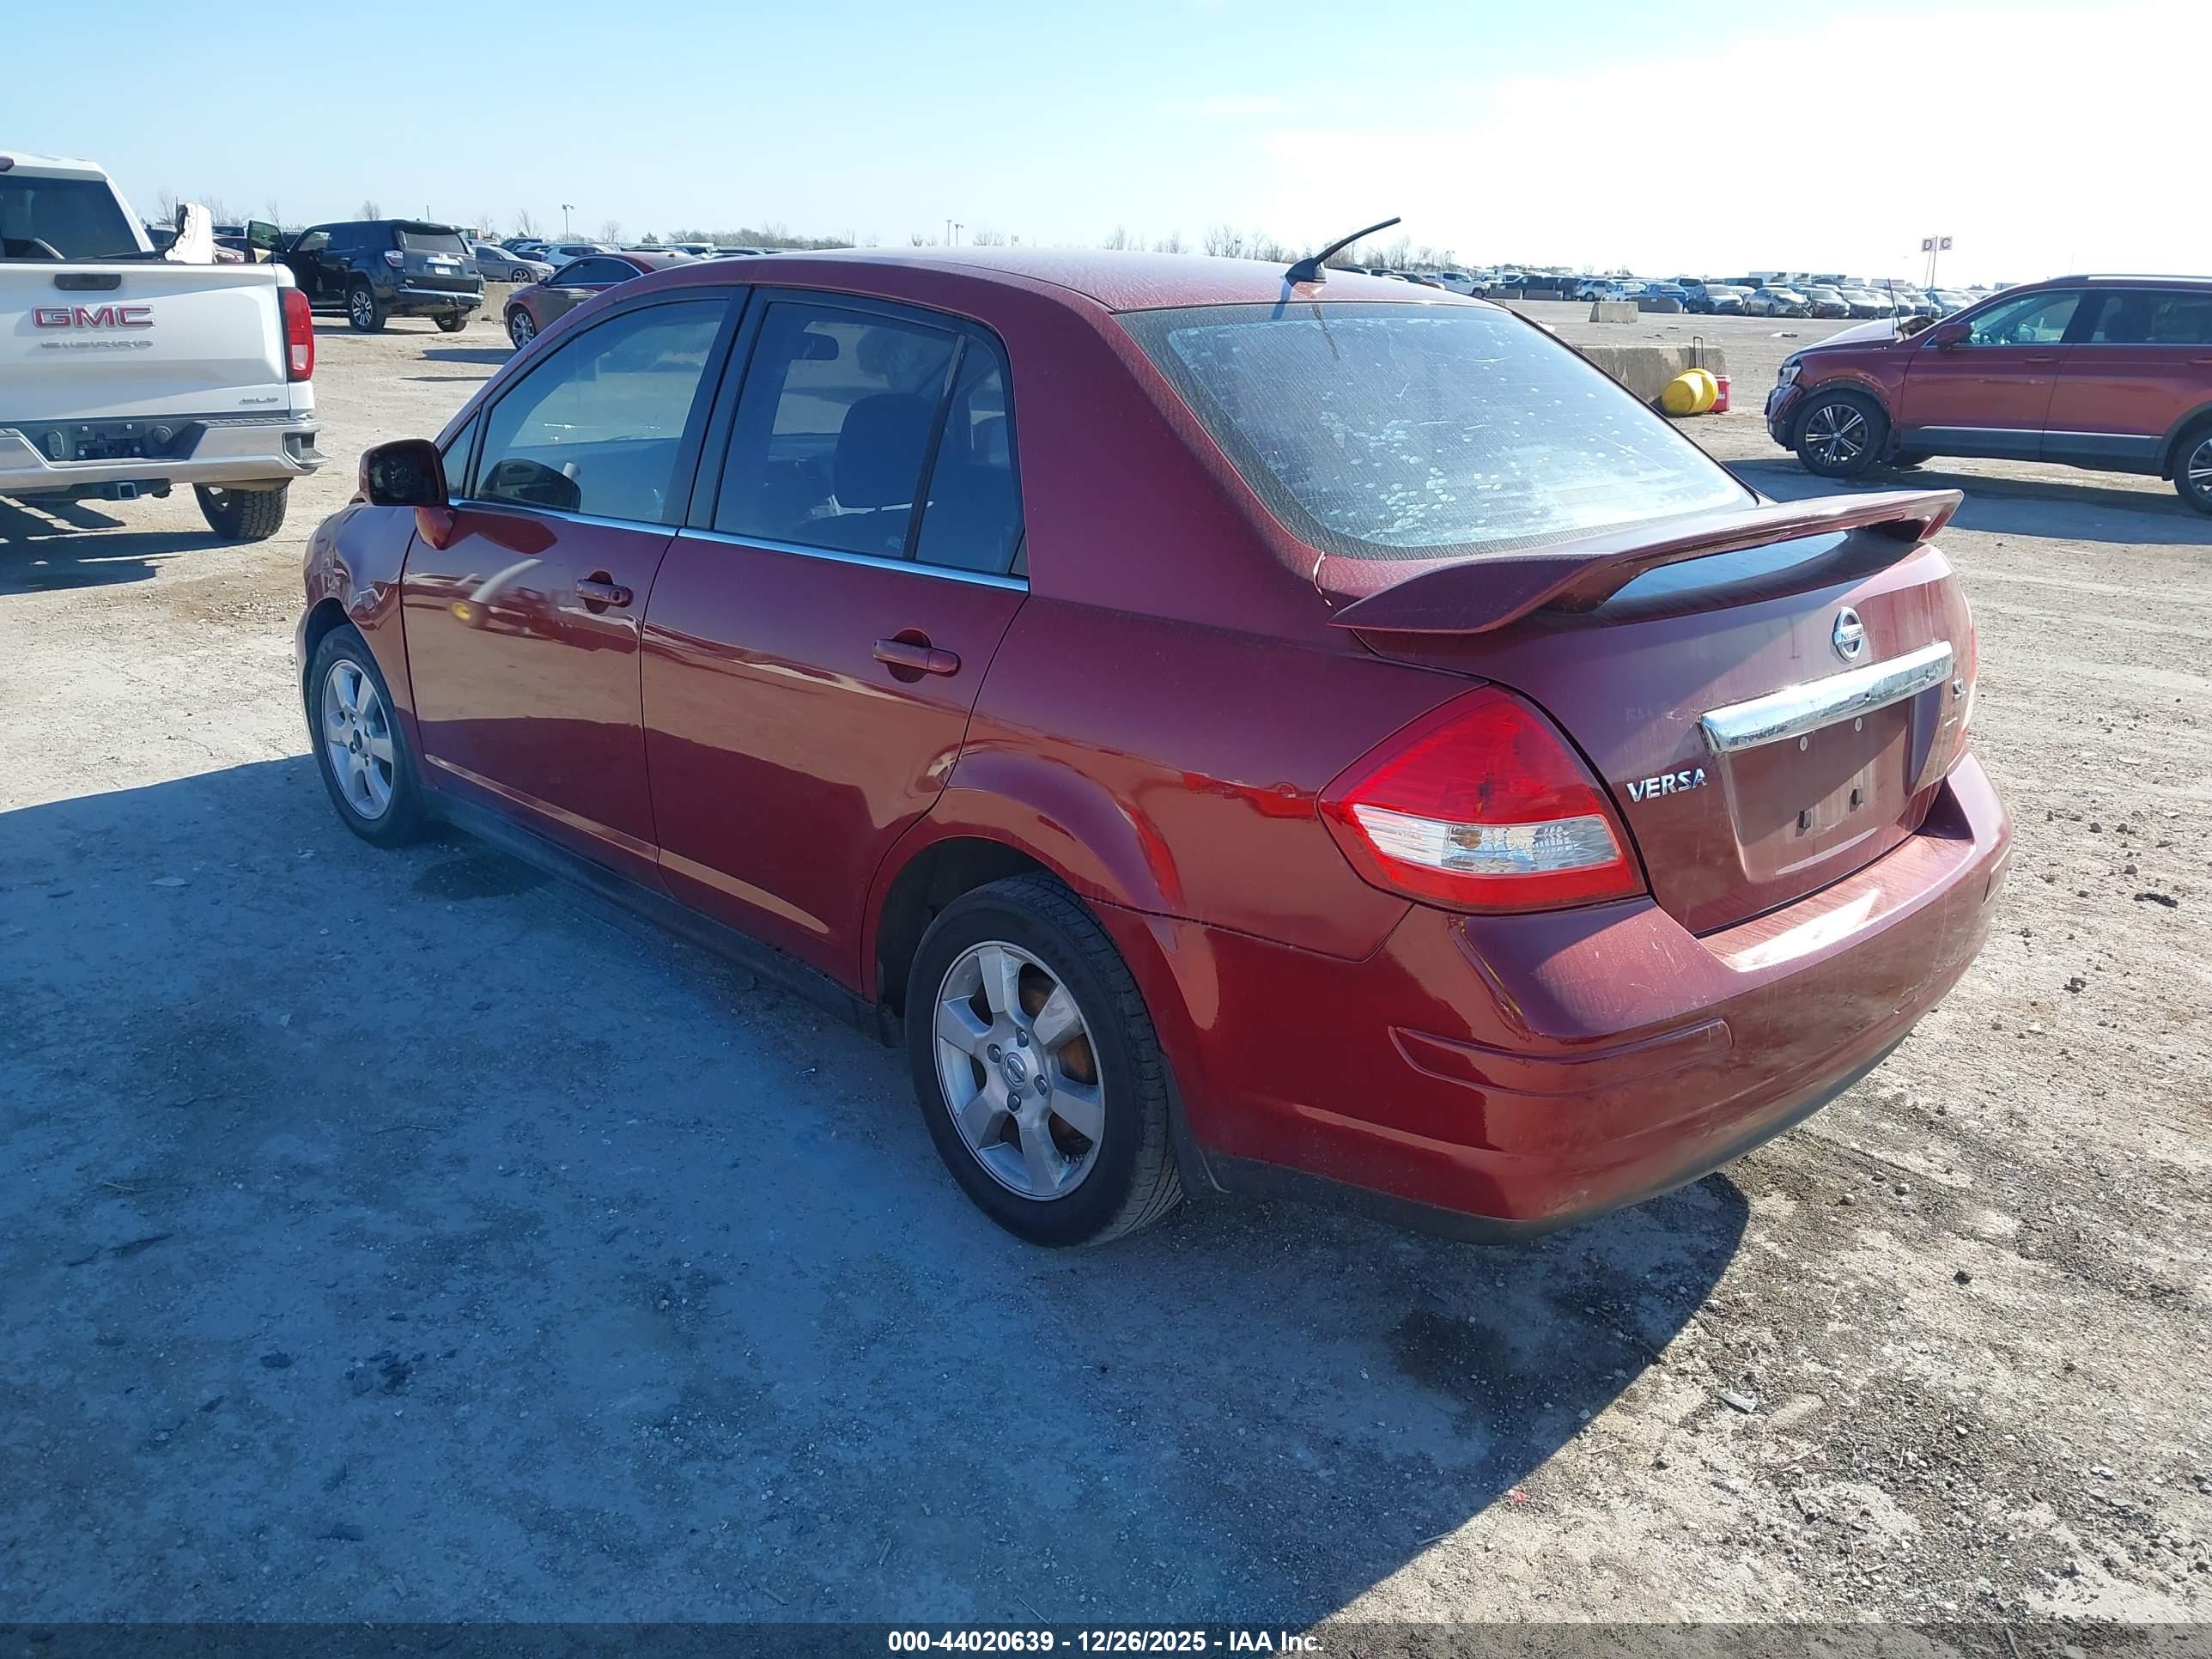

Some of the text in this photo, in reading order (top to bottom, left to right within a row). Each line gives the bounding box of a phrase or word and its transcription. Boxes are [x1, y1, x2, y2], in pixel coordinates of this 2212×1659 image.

[1923, 240, 1932, 251] D
[1941, 238, 1950, 249] C
[33, 305, 156, 329] GMC
[1626, 768, 1708, 803] VERSA
